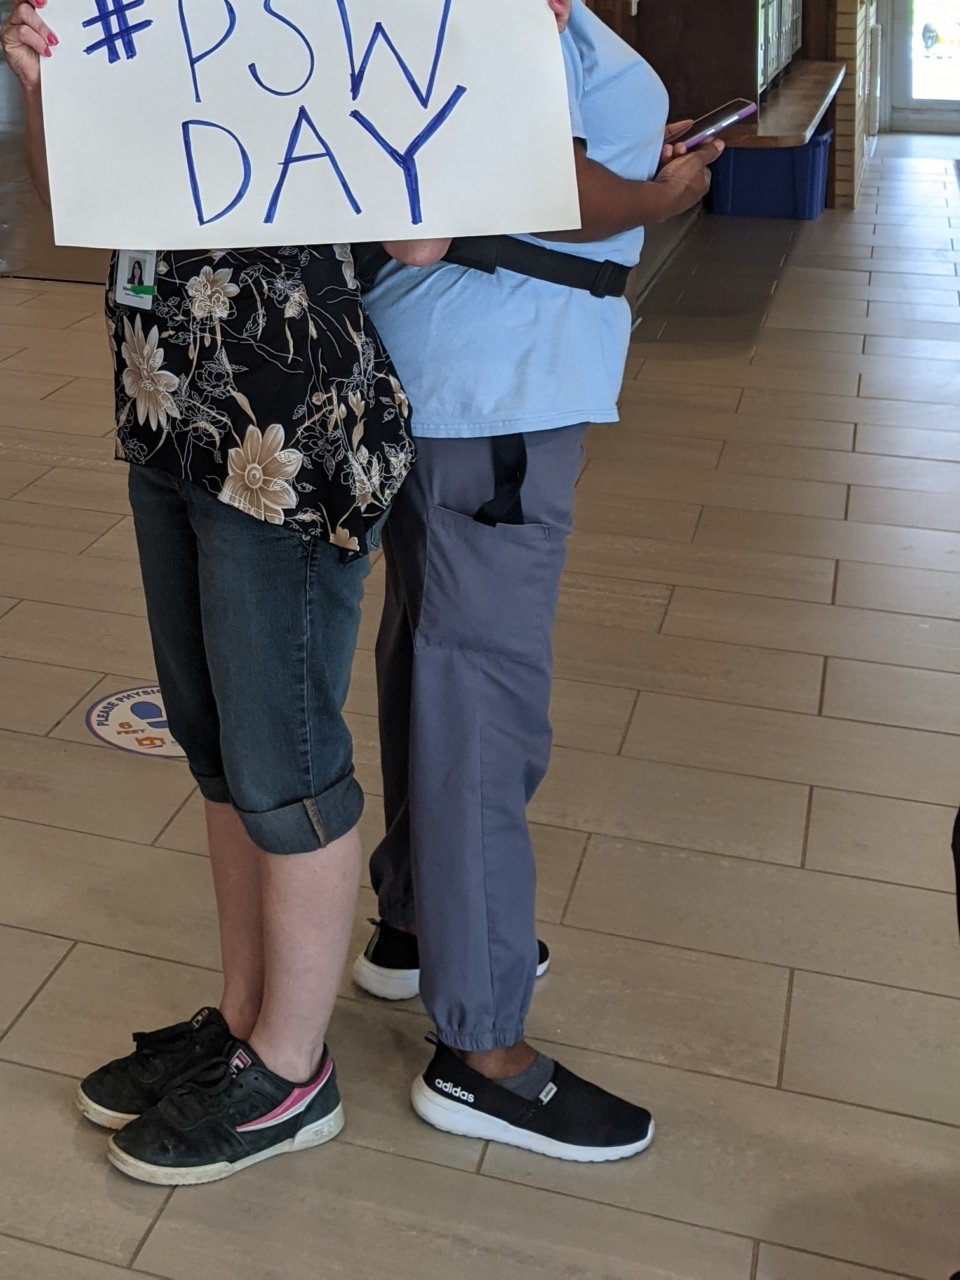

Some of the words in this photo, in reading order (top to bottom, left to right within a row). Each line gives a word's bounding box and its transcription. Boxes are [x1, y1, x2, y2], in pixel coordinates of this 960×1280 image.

[181, 85, 467, 226] DAY
[96, 701, 119, 726] PLEASE
[118, 721, 133, 730] 6
[435, 1079, 475, 1103] adidas
